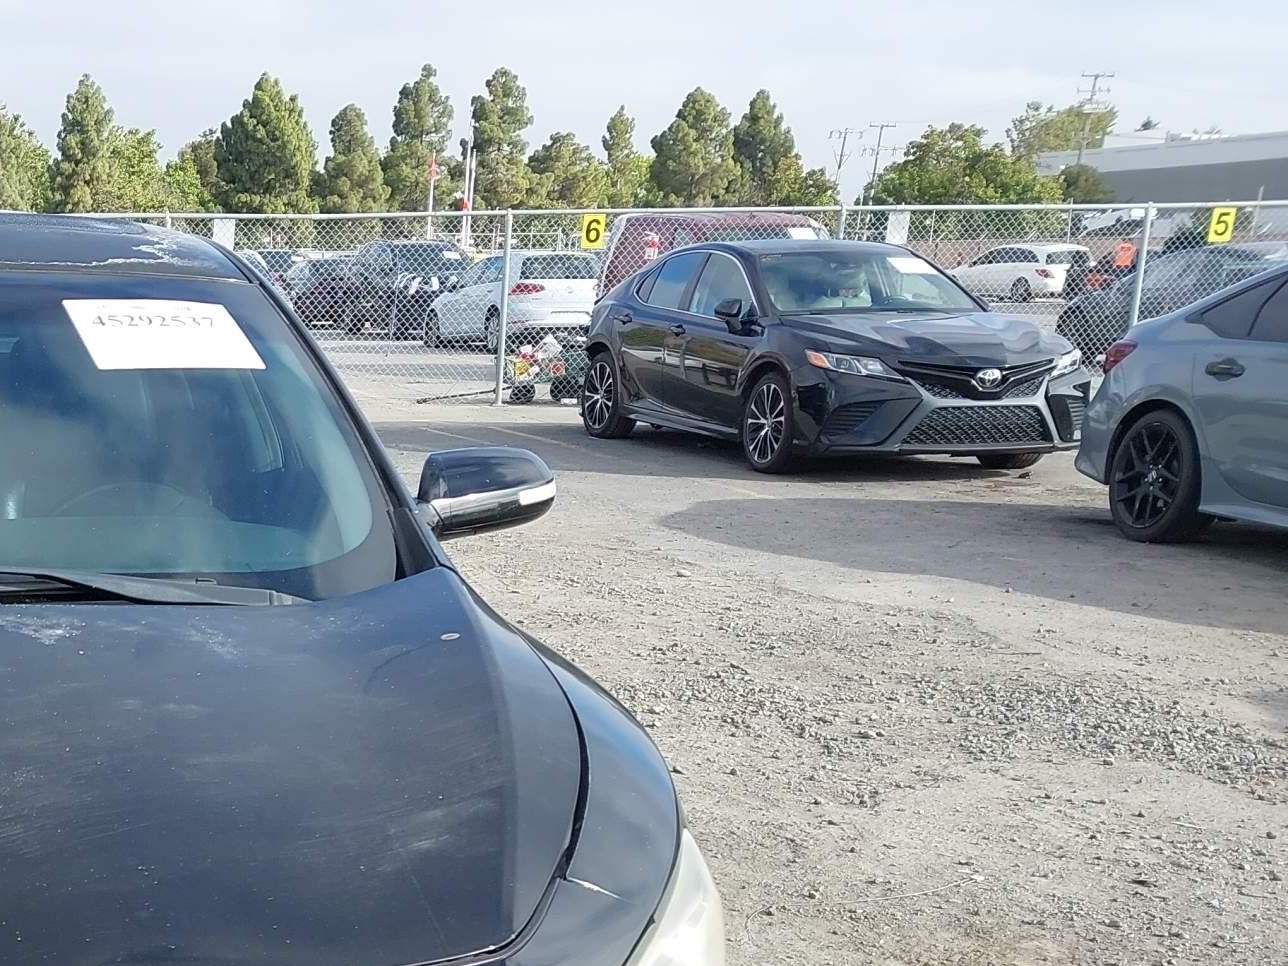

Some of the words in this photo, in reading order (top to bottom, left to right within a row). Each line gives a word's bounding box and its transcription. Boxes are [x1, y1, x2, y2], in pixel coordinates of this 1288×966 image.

[585, 219, 601, 243] 6
[1214, 212, 1231, 236] 5
[92, 314, 214, 328] 45292537
